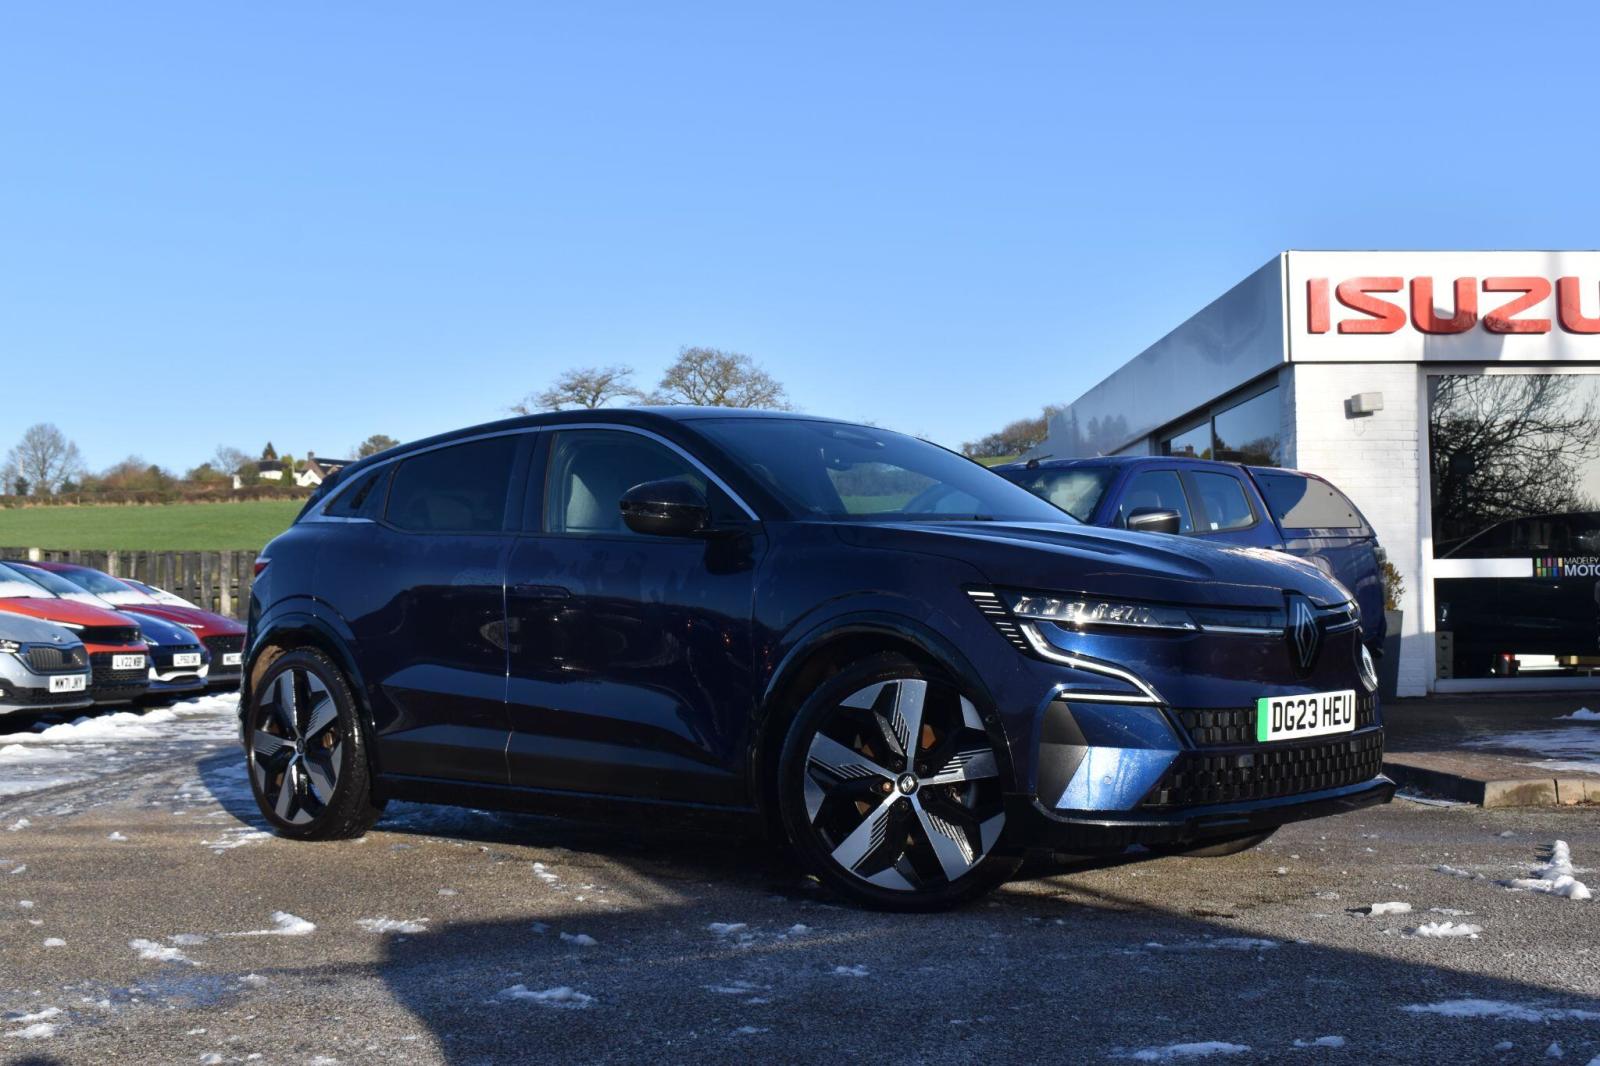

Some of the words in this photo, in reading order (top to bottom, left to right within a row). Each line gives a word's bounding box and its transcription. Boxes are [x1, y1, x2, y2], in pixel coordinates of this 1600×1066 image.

[1306, 276, 1600, 334] ISUZU
[1271, 699, 1318, 733] DG23
[1322, 694, 1353, 728] HEU
